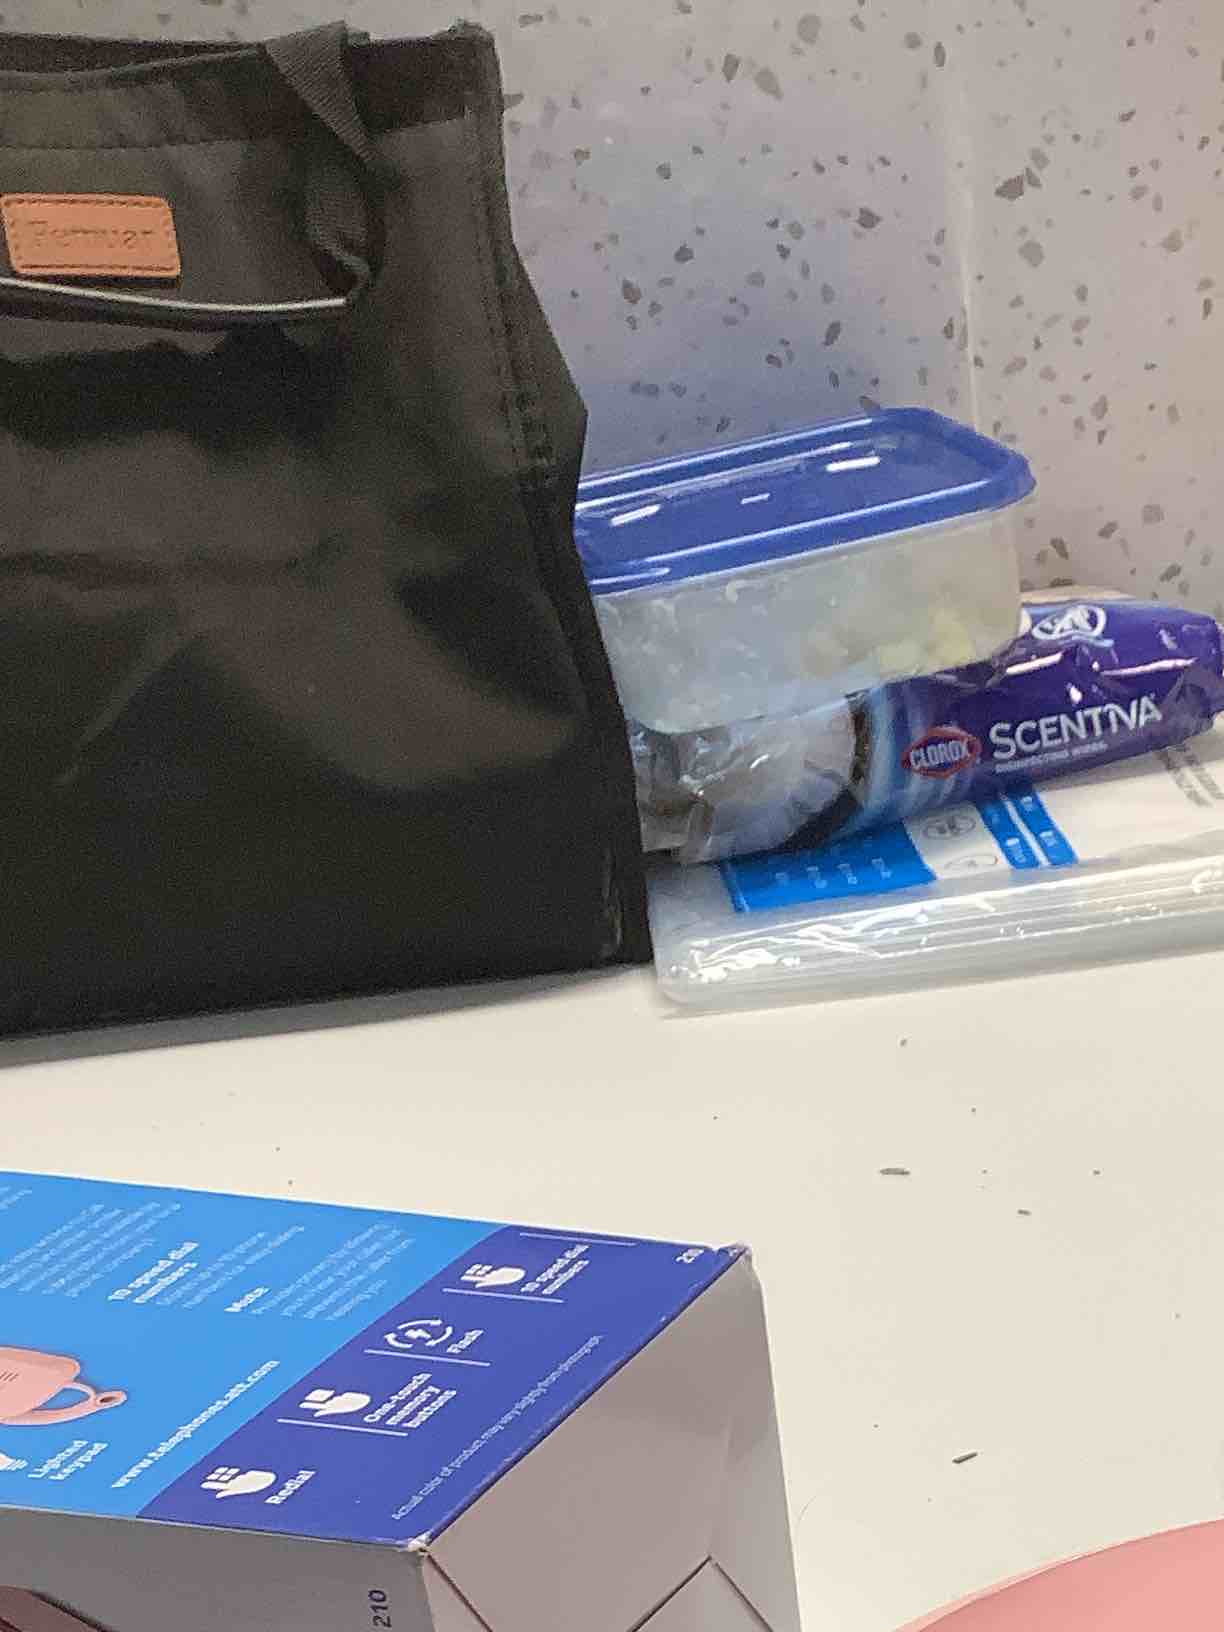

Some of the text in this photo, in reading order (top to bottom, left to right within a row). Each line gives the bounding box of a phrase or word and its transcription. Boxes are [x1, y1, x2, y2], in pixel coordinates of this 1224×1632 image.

[989, 694, 1163, 760] SCENTIVA
[910, 739, 969, 772] CLOROX
[363, 1372, 433, 1424] One-touch
[111, 1359, 281, 1489] www.telephones.att.com
[263, 1470, 316, 1505] Redial
[391, 1494, 424, 1520] Actual
[367, 1589, 393, 1629] 210
